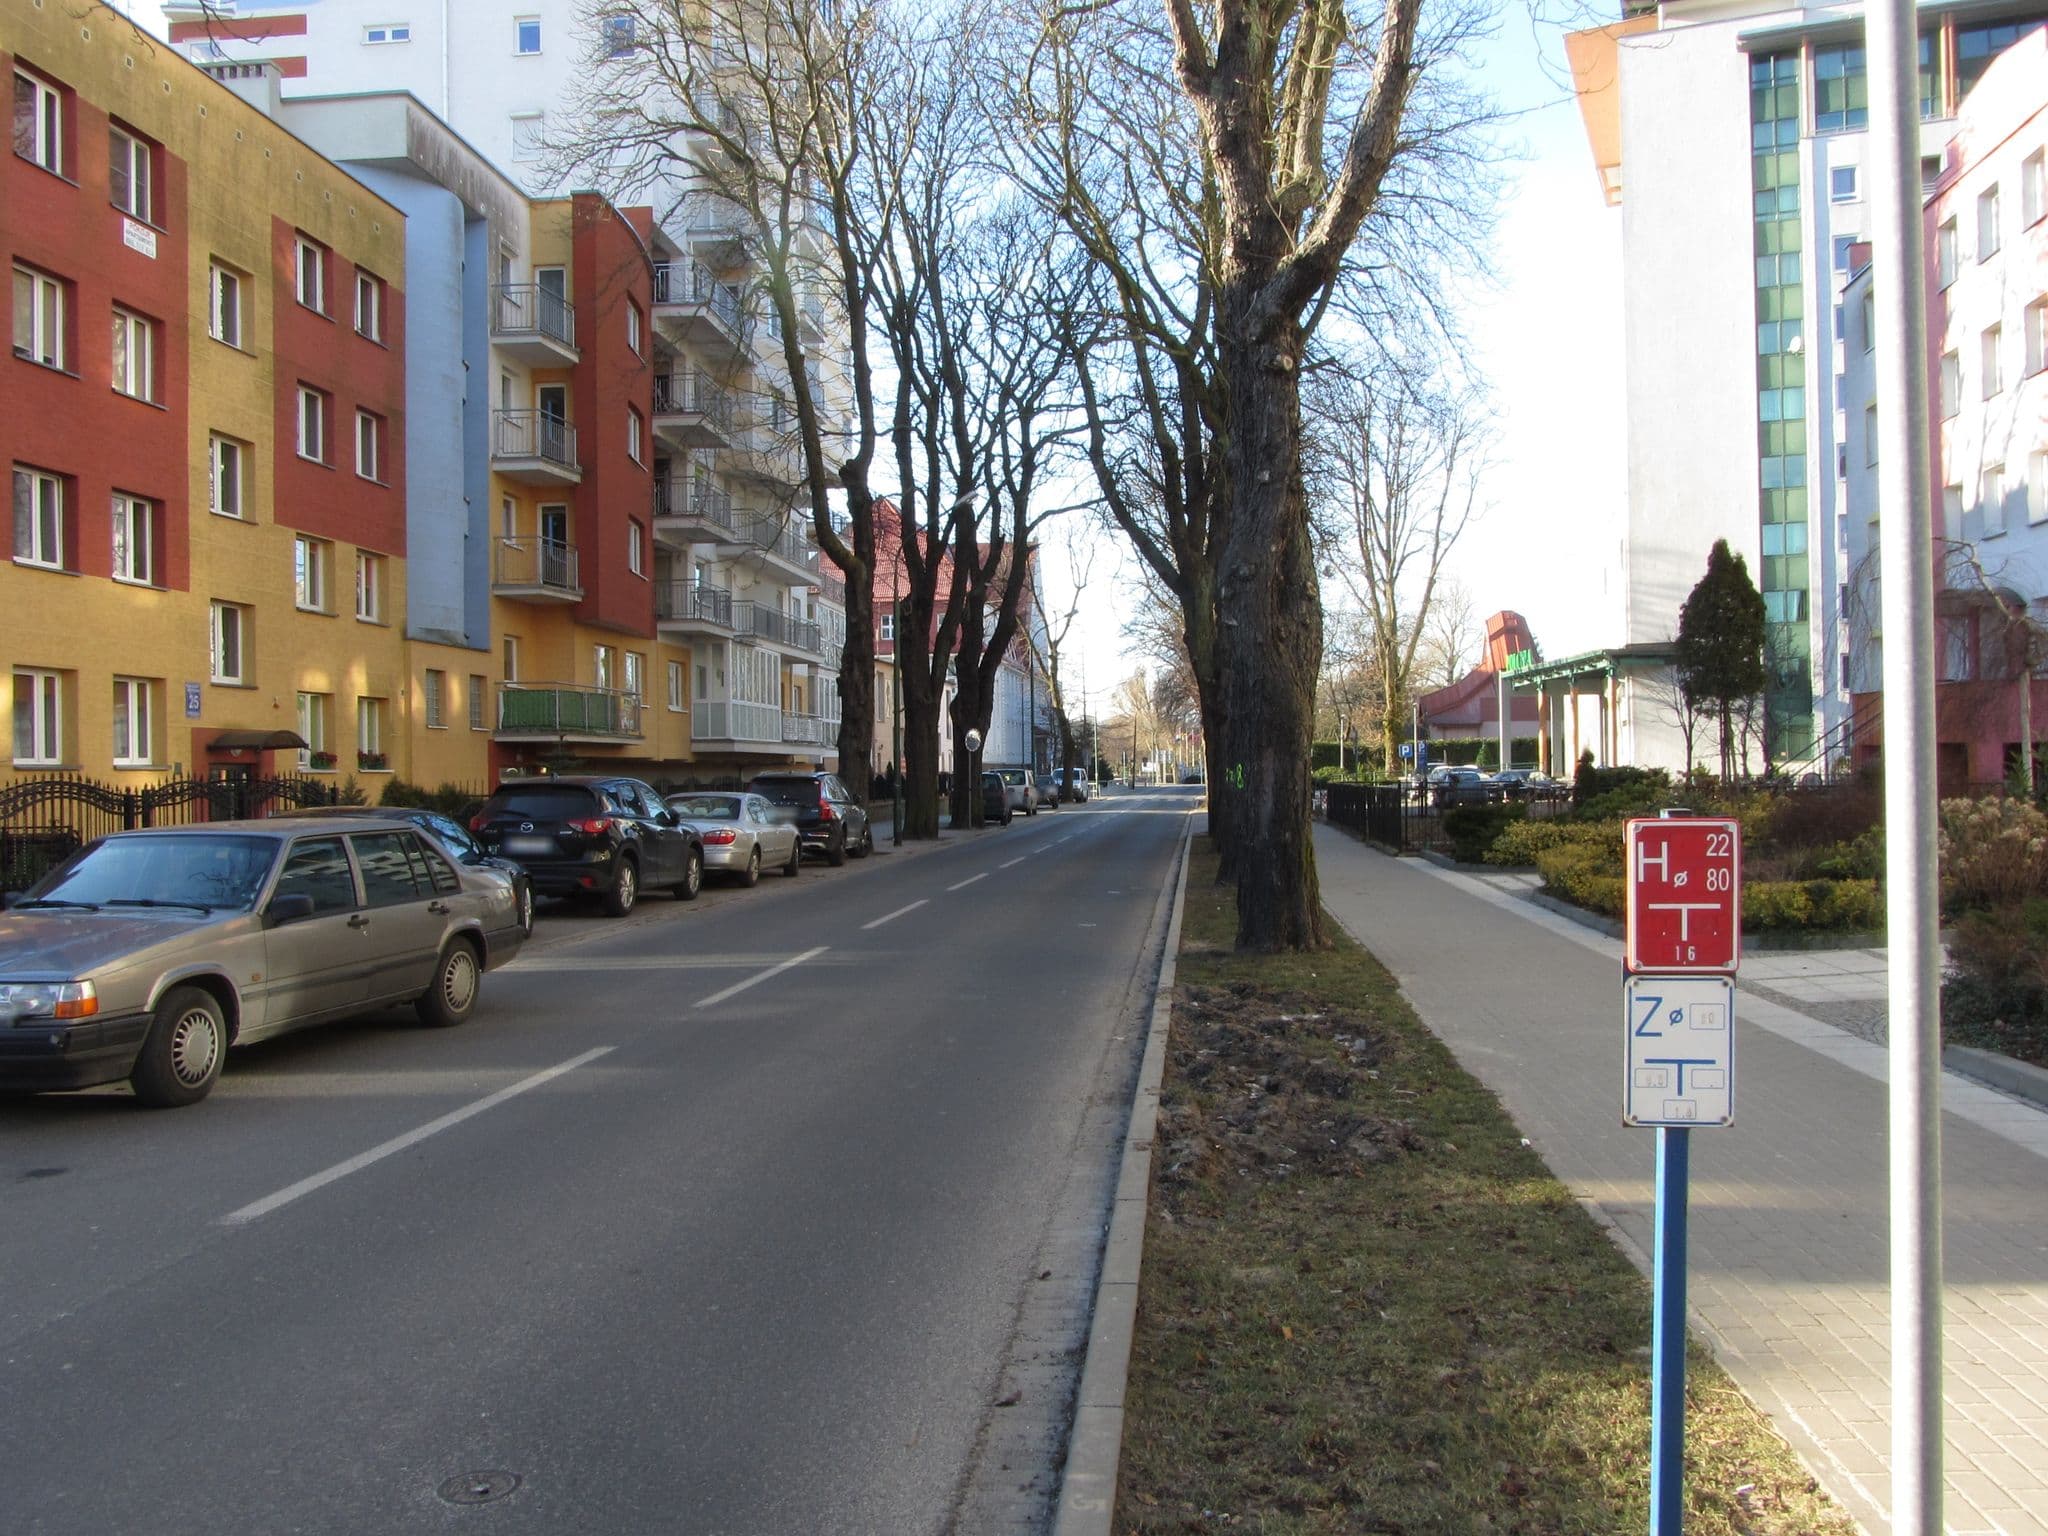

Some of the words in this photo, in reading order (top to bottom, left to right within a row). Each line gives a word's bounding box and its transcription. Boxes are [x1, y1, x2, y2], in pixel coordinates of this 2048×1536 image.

[188, 694, 199, 709] 25
[1401, 745, 1410, 756] P
[1638, 841, 1668, 882] H
[1706, 833, 1729, 857] 22
[1706, 868, 1729, 891] 80
[1635, 996, 1663, 1037] Z
